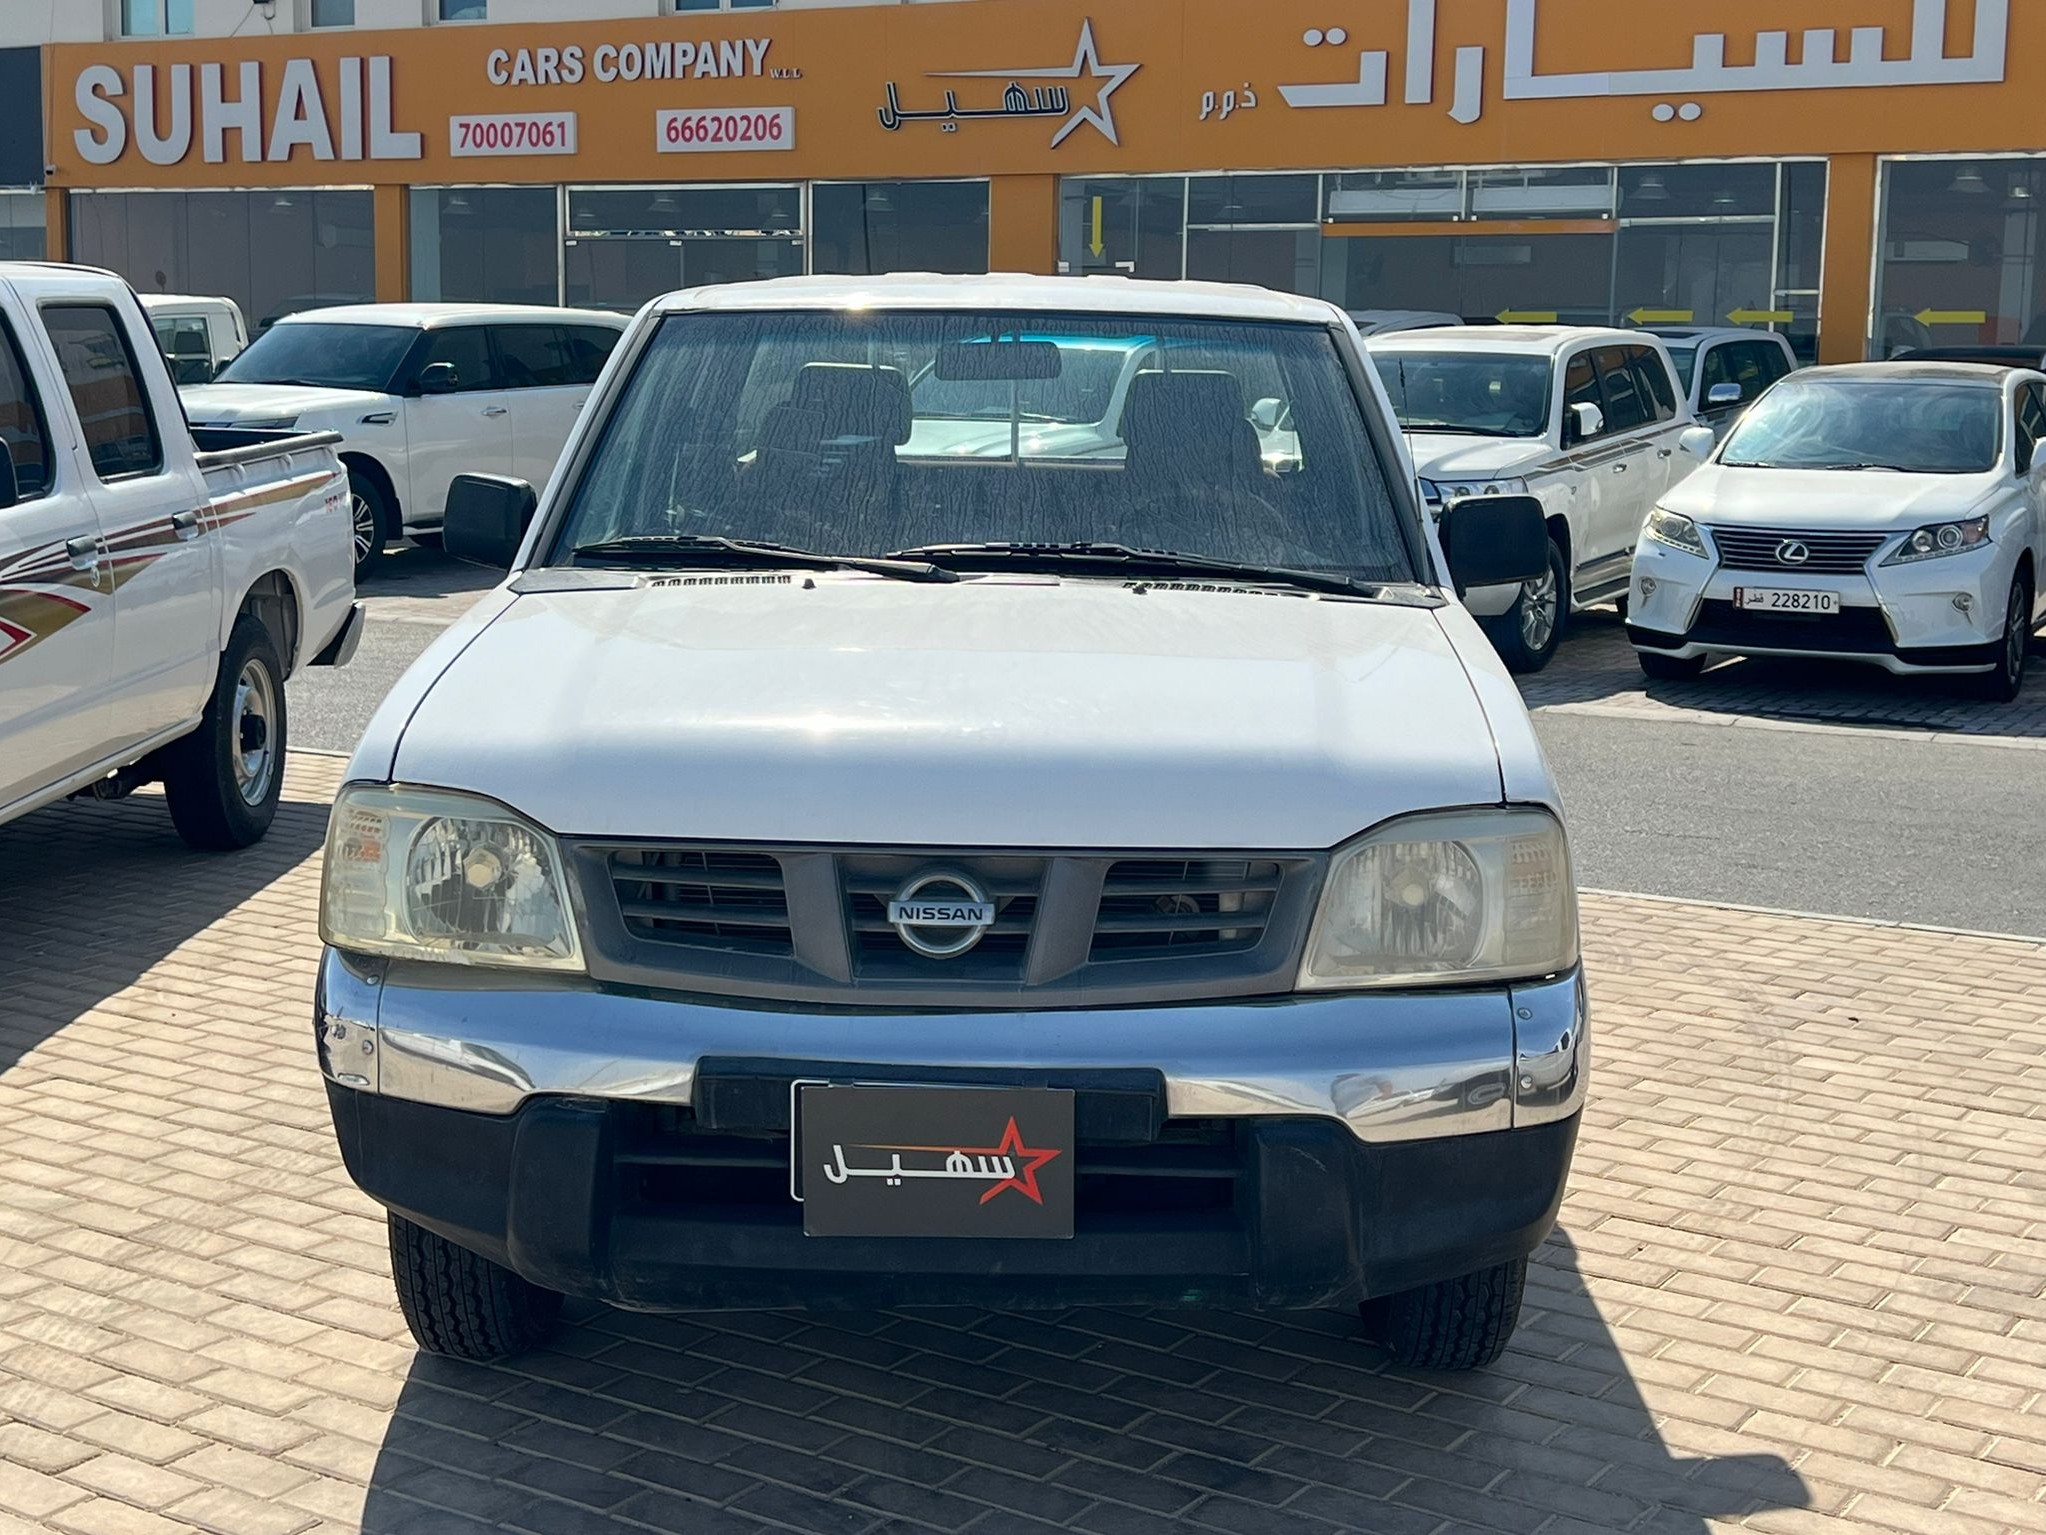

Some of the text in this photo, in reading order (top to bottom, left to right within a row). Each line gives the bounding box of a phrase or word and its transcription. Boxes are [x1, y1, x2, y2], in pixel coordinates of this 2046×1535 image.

[486, 45, 585, 86] CARS
[593, 38, 771, 82] COMPANY
[73, 55, 423, 166] SUHAIL
[876, 81, 1070, 132] سهيل
[458, 120, 568, 149] 70007061
[665, 113, 784, 143] 66620206
[1771, 592, 1831, 610] 228210
[899, 905, 984, 922] NISSAN
[823, 1143, 1016, 1186] سهيل
